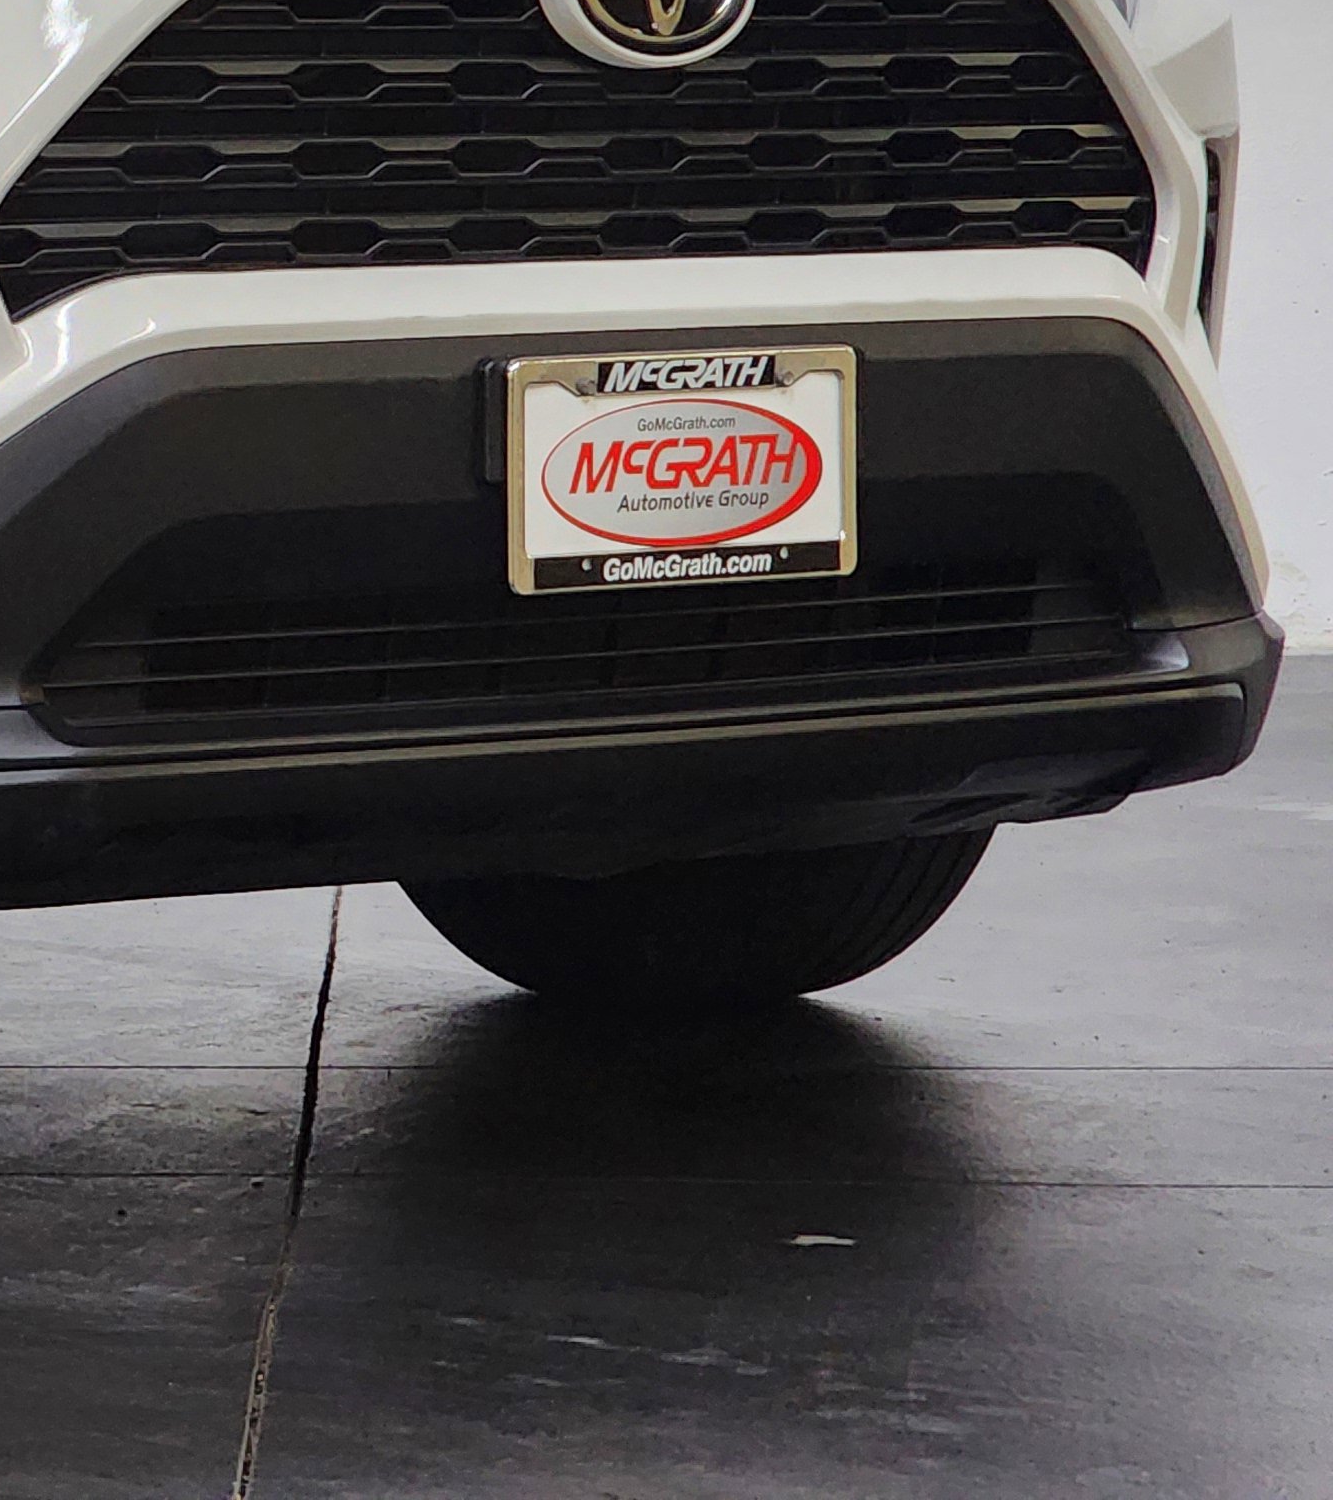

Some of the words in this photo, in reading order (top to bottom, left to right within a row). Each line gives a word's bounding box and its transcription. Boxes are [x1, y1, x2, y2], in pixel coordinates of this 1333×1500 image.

[637, 416, 736, 432] GoMcGrath.com
[617, 490, 715, 514] Automotive
[718, 488, 770, 510] Group
[603, 550, 773, 583] GoMcGrath.com
